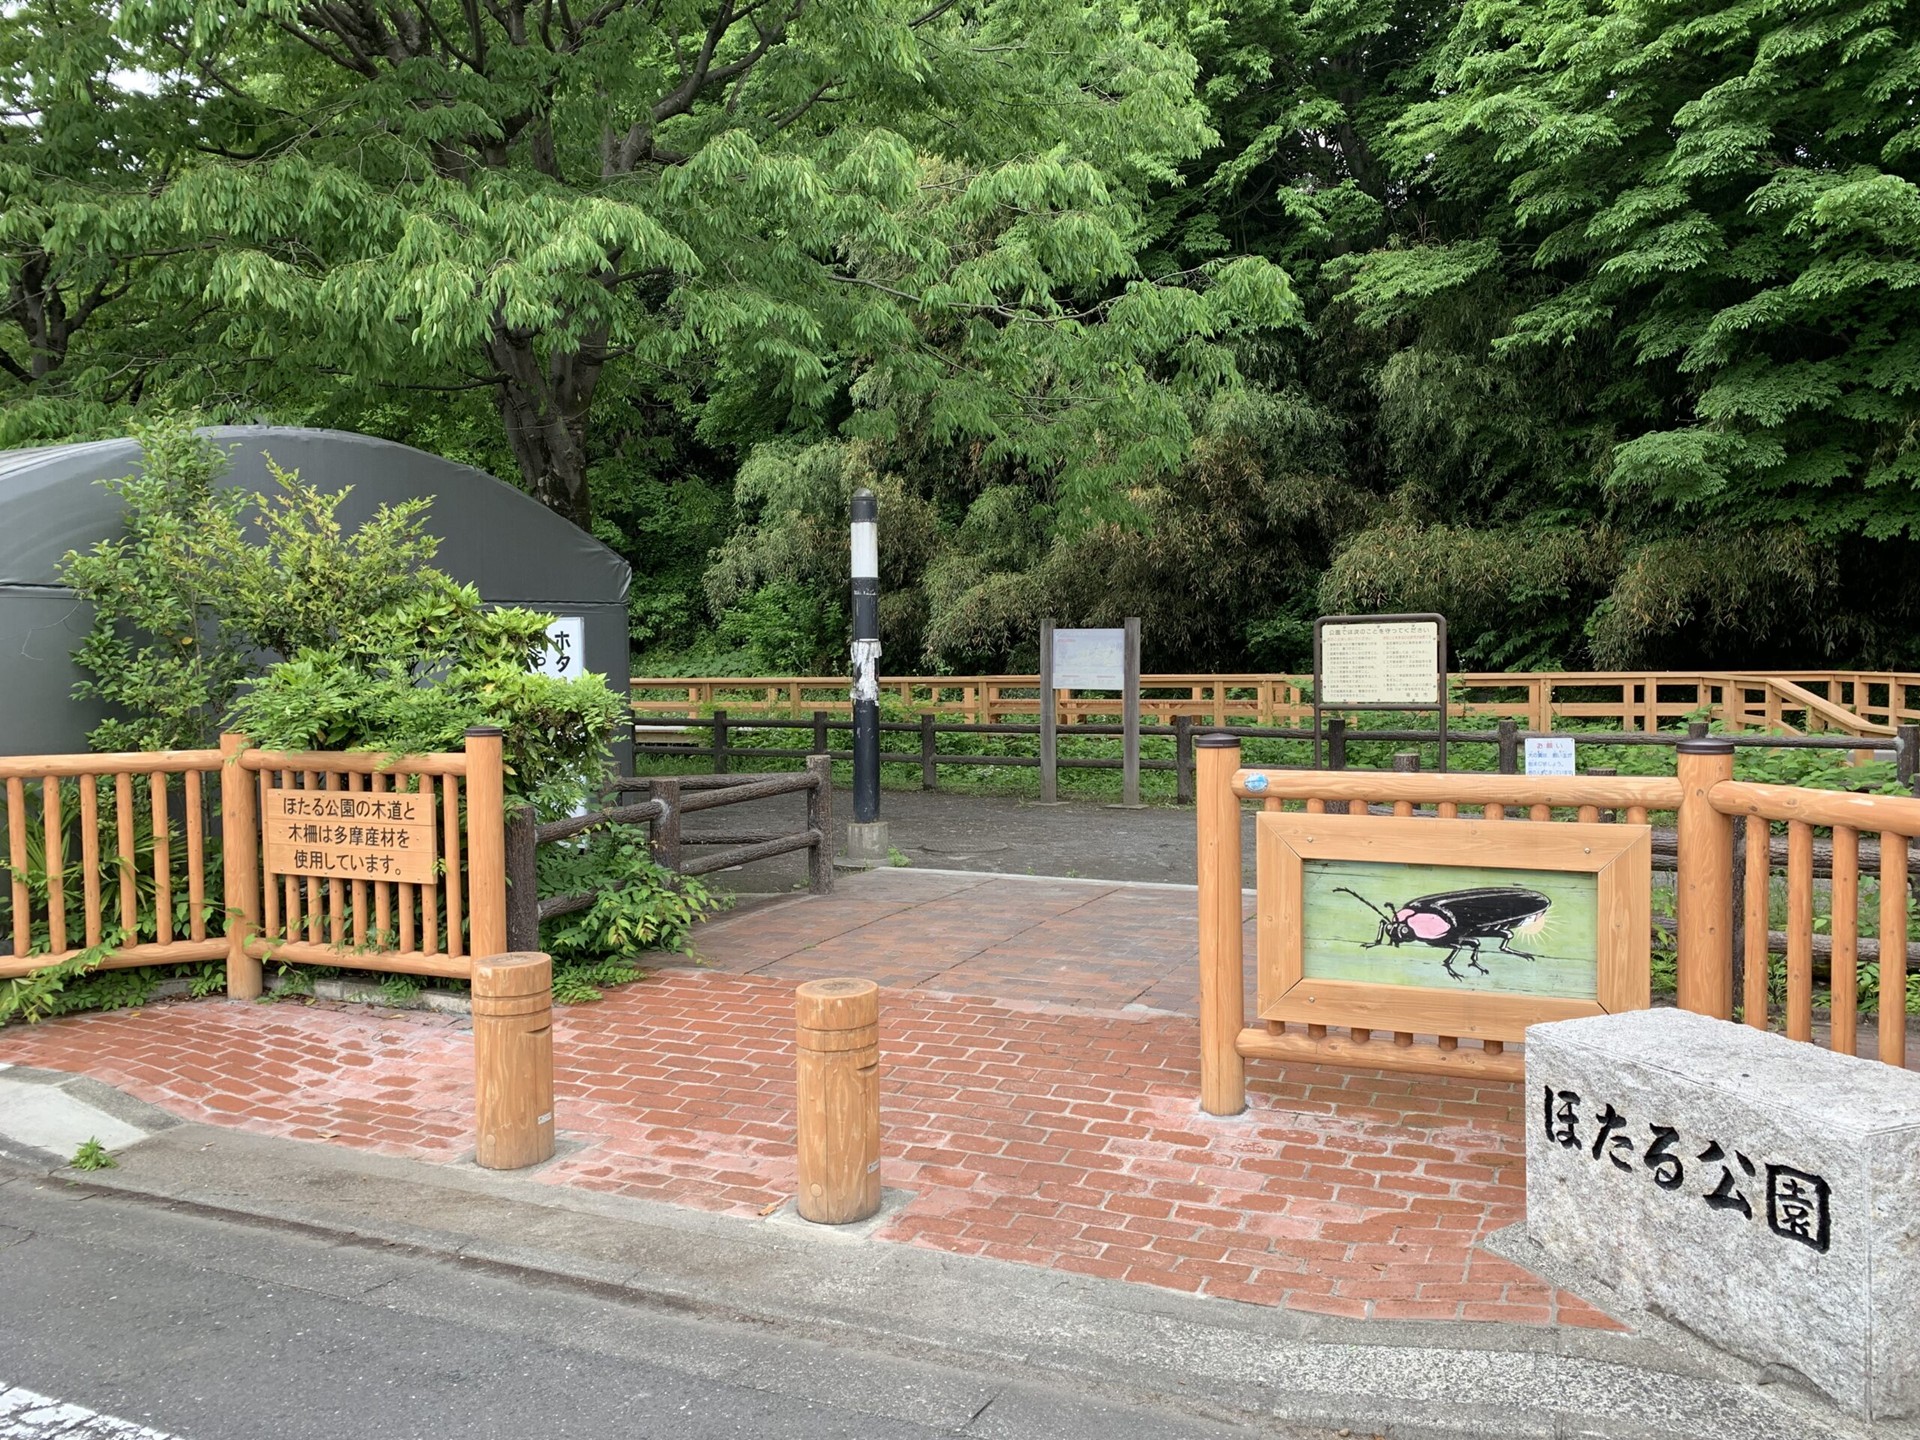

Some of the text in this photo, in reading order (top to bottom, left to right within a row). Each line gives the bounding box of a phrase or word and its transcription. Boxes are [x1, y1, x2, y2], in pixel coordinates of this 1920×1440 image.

[283, 797, 415, 821] ほたる公園の木道と
[288, 823, 410, 849] 木柵は多摩産材を
[294, 849, 402, 876] 使用しています。
[1543, 1084, 1832, 1255] ほたる公園
